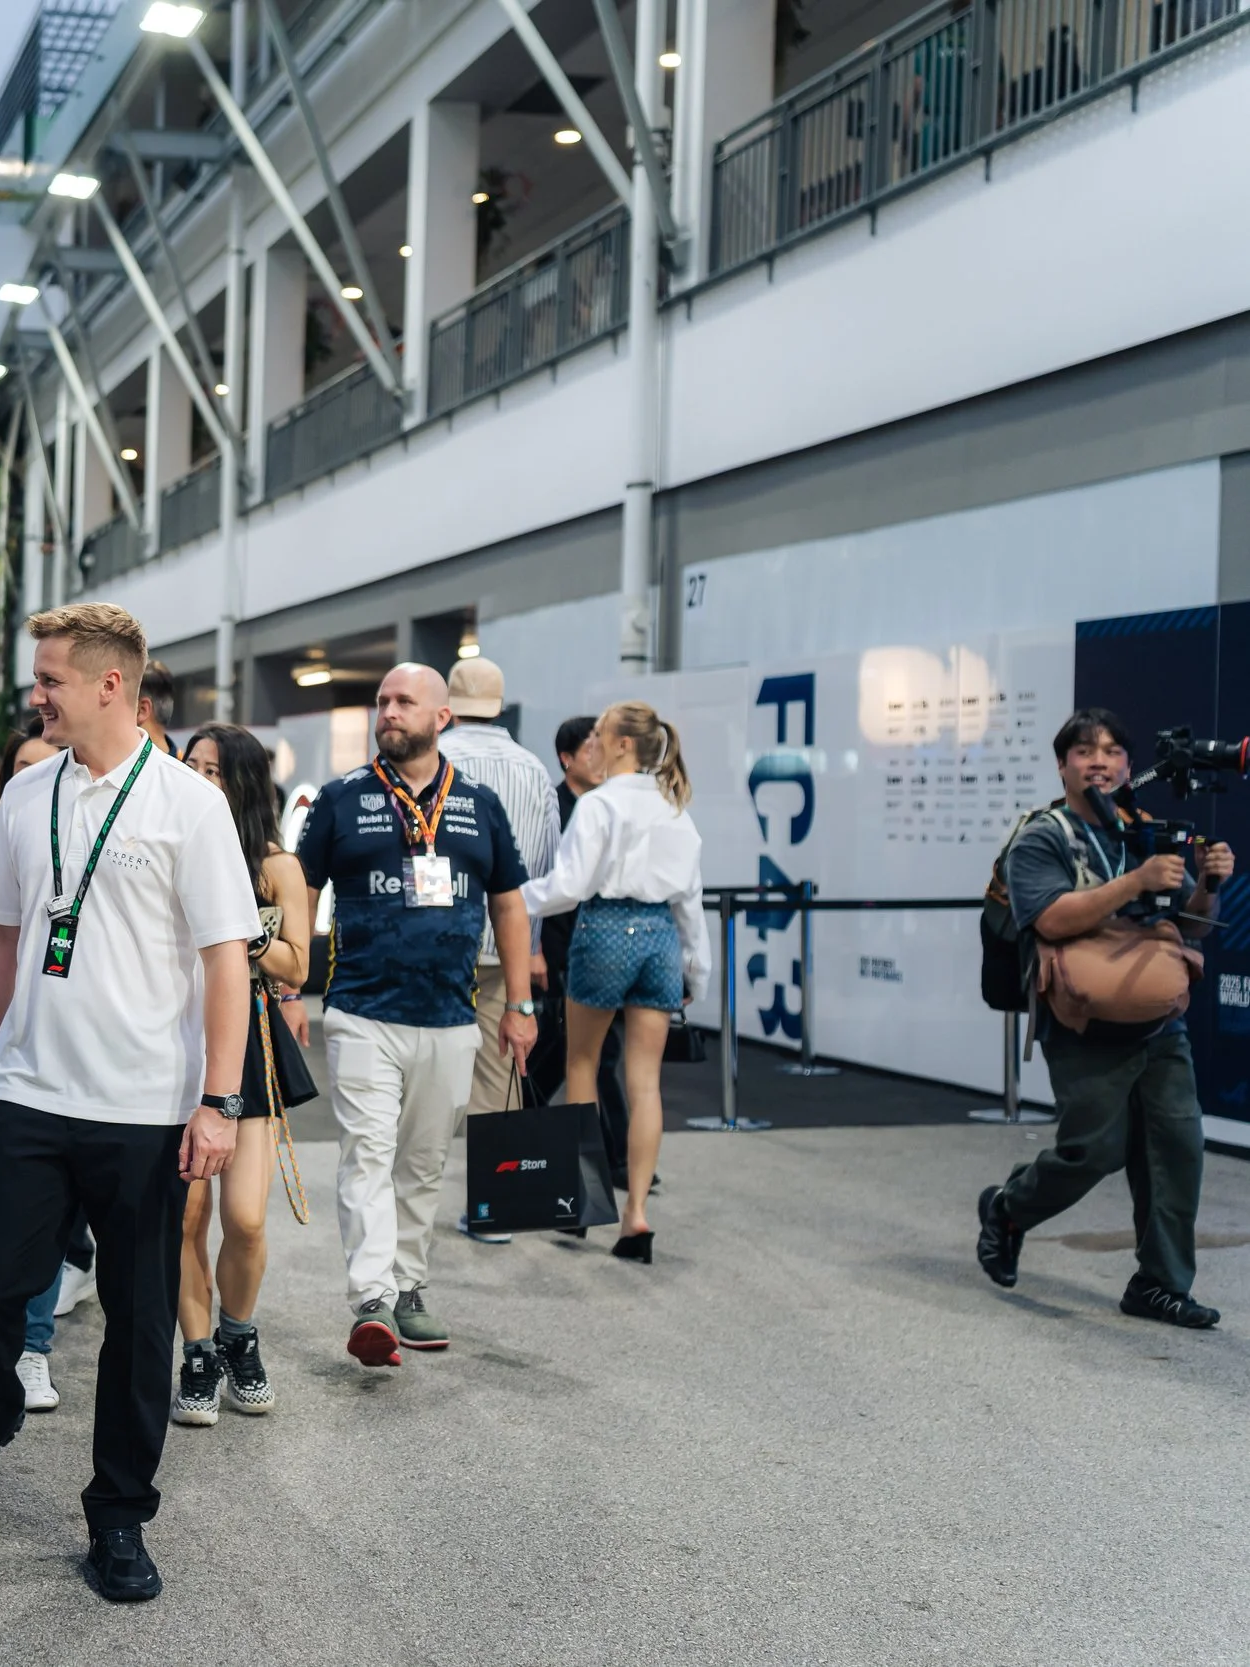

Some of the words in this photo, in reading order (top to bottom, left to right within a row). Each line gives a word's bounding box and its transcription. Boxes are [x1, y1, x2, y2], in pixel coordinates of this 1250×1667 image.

[687, 573, 707, 609] 27
[357, 814, 383, 824] Mobil
[444, 814, 477, 825] HONDA
[358, 825, 393, 834] ORACLE
[106, 848, 150, 866] EXPERT
[370, 869, 407, 895] Re
[50, 936, 73, 949] PDK
[1219, 973, 1241, 990] 2025
[1219, 989, 1250, 1008] WORLD
[520, 1160, 547, 1171] Store
